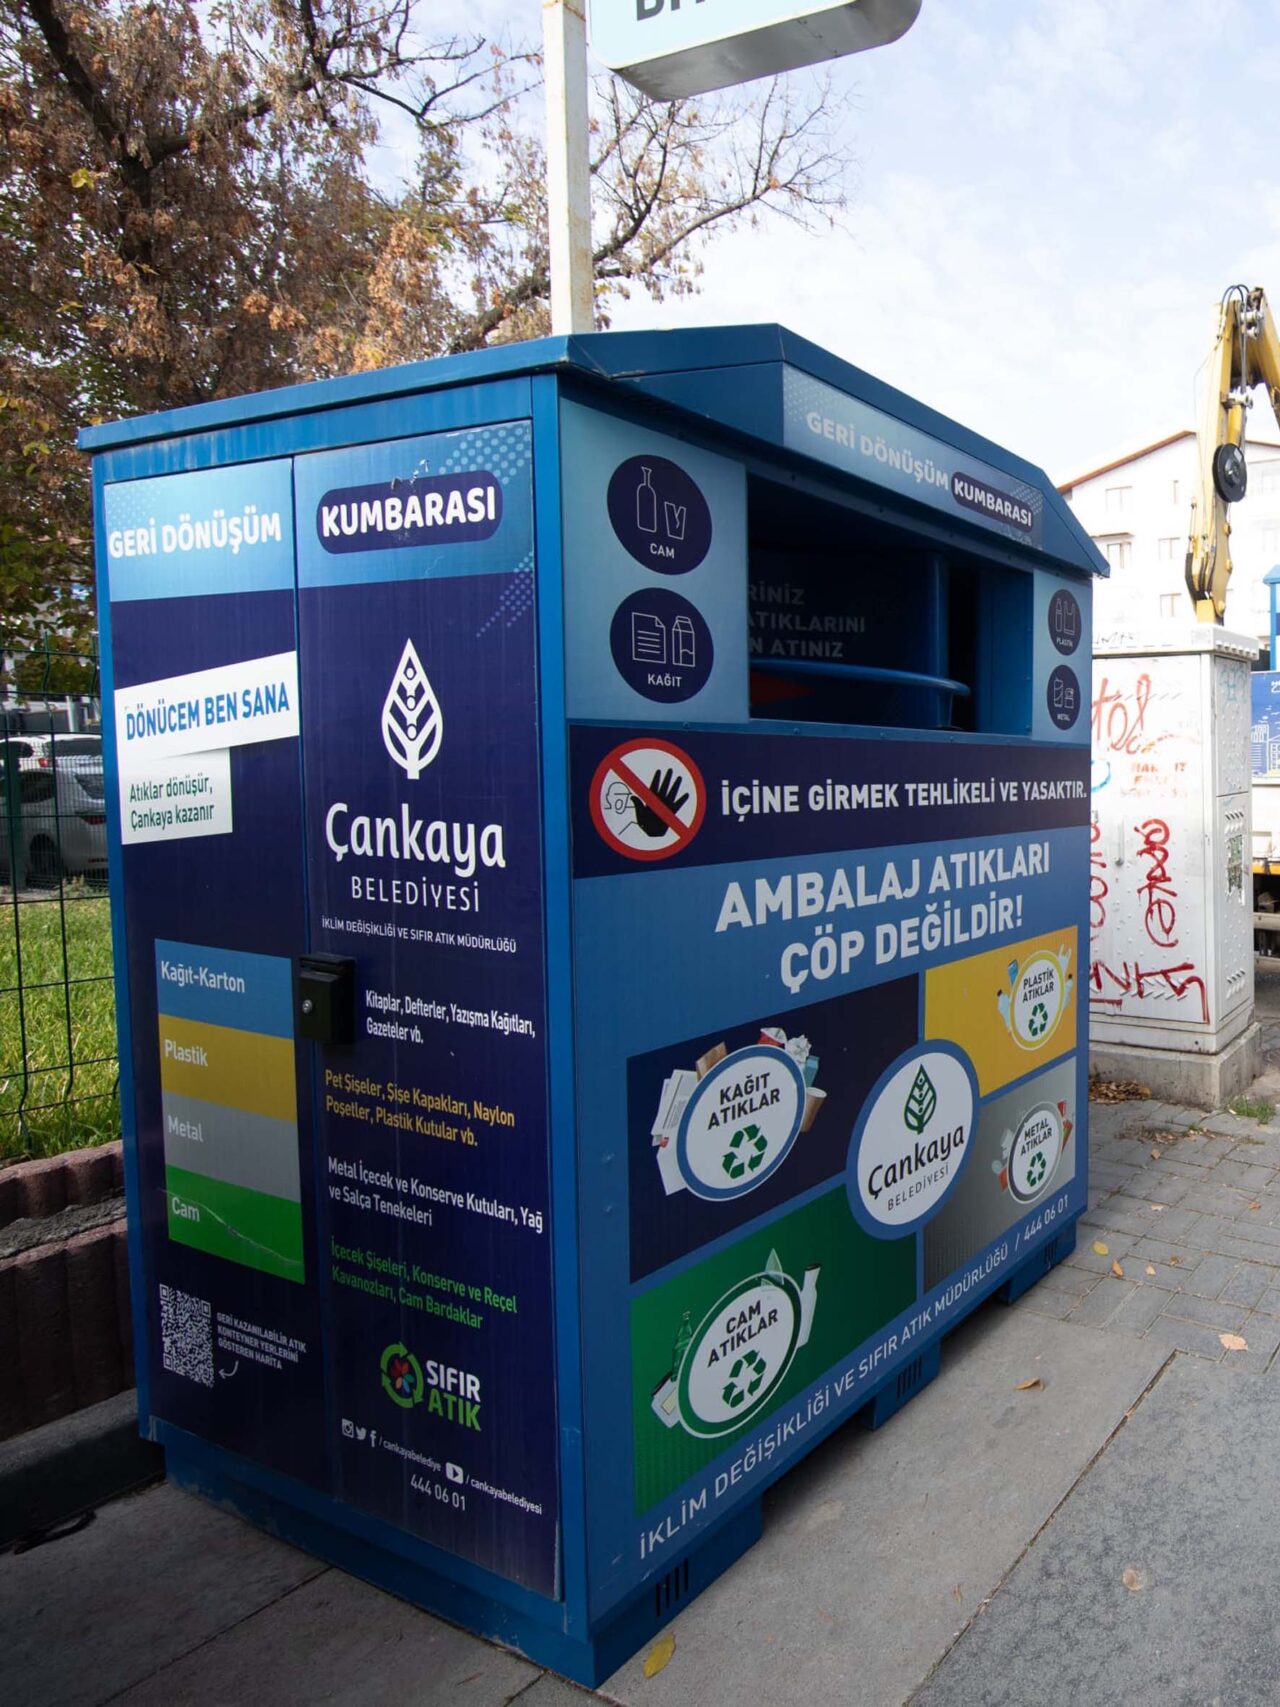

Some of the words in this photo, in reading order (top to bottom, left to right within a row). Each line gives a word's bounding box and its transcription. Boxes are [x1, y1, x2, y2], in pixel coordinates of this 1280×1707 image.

[806, 411, 855, 451] GERİ
[860, 433, 949, 492] DÖNÜŞÜM
[953, 475, 1033, 528] KUMBARASI
[109, 518, 157, 559] GERİ
[162, 505, 282, 554] DÖNÜŞÜM
[321, 486, 496, 538] KUMBARASI
[649, 542, 676, 560] CAM
[647, 669, 682, 688] KAĞIT
[126, 698, 201, 741] DÖNÜCEM
[204, 690, 239, 726] BEN
[242, 681, 291, 717] SANA
[129, 780, 164, 803] Atıklar
[165, 772, 214, 798] dönüşür,
[721, 778, 800, 822] İÇİNE
[808, 778, 899, 812] GİRMEK
[904, 776, 996, 807] TEHLİKELİ
[999, 781, 1019, 802] VE
[1022, 779, 1088, 801] YASAKTIR.
[130, 808, 174, 833] Çankaya
[175, 803, 215, 826] kazanır
[326, 802, 506, 878] Çankaya
[350, 876, 480, 913] BELEDİYESİ
[715, 869, 921, 933] AMBALAJ
[928, 841, 1051, 894] ATIKLARI
[321, 915, 344, 932] İKLİM
[346, 918, 397, 939] DEĞİŞİKLİĞİ
[397, 927, 409, 939] VE
[410, 927, 434, 943] SIFIR
[435, 931, 455, 945] ATIK
[457, 933, 517, 954] MÜDÜRLÜĞÜ
[780, 924, 866, 994] ÇÖP
[875, 894, 1024, 965] DEĞİLDİR!
[160, 960, 246, 994] Kağıt-Karton
[1021, 981, 1055, 1003] ATIKLAR
[1022, 966, 1055, 990] PLASTİK
[365, 989, 404, 1014] Kitaplar,
[404, 995, 450, 1023] Defterler,
[450, 1001, 490, 1030] Yazışma
[490, 1011, 536, 1039] Kağıtları,
[366, 1017, 409, 1041] Gazeteler
[410, 1025, 424, 1044] vb.
[164, 1039, 209, 1068] Plastik
[325, 1069, 343, 1089] Pet
[344, 1073, 386, 1101] Şişeler,
[387, 1081, 412, 1104] Şişe
[413, 1087, 471, 1121] Kapakları,
[473, 1101, 515, 1128] Naylon
[706, 1086, 781, 1131] ATIKLAR
[719, 1072, 772, 1107] KAĞIT
[168, 1115, 204, 1143] Metal
[326, 1095, 374, 1125] Poşetler,
[375, 1106, 414, 1132] Plastik
[415, 1115, 459, 1142] Kutular
[460, 1126, 479, 1147] vb.
[1023, 1116, 1050, 1142] METAL
[868, 1124, 965, 1201] Çankaya
[1019, 1130, 1053, 1157] ATIKLAR
[172, 1195, 200, 1222] Cam
[328, 1156, 359, 1182] Metal
[359, 1159, 396, 1191] İçecek
[396, 1176, 409, 1192] ve
[411, 1178, 465, 1208] Konserve
[466, 1191, 519, 1225] Kutuları,
[520, 1204, 543, 1235] Yağ
[328, 1185, 342, 1200] ve
[343, 1187, 372, 1211] Salça
[373, 1193, 433, 1227] Tenekeleri
[887, 1164, 950, 1212] BELEDİYESİ
[331, 1234, 365, 1266] İçecek
[366, 1246, 410, 1281] Şişeleri,
[411, 1257, 466, 1292] Konserve
[467, 1284, 482, 1302] ve
[484, 1282, 517, 1315] Reçel
[332, 1266, 397, 1303] Kavanozları,
[399, 1286, 423, 1309] Cam
[425, 1293, 483, 1330] Bardaklar
[725, 1299, 762, 1334] CAM
[217, 1312, 233, 1324] GERİ
[233, 1317, 288, 1346] KAZANILABİLİR
[289, 1338, 307, 1353] ATIK
[217, 1325, 260, 1349] KONTEYNER
[260, 1341, 299, 1363] YERLERİNİ
[218, 1337, 254, 1359] GÖSTEREN
[255, 1352, 283, 1370] HARİTA
[707, 1308, 780, 1367] ATIKLAR
[426, 1359, 481, 1402] SIFIR
[640, 1488, 709, 1560] İKLİM
[715, 1385, 831, 1500] DEĞİŞİKLİĞİ
[835, 1366, 856, 1399] VE
[858, 1335, 899, 1377] SIFIR
[900, 1308, 933, 1348] ATIK
[934, 1241, 1009, 1318] MÜDÜRLÜĞÜ
[1023, 1213, 1043, 1241] 444
[1044, 1203, 1056, 1225] 06
[1057, 1193, 1069, 1214] 01
[427, 1389, 482, 1432] ATIK
[410, 1474, 432, 1497] 444
[434, 1484, 450, 1504] 06
[452, 1489, 467, 1512] 01
